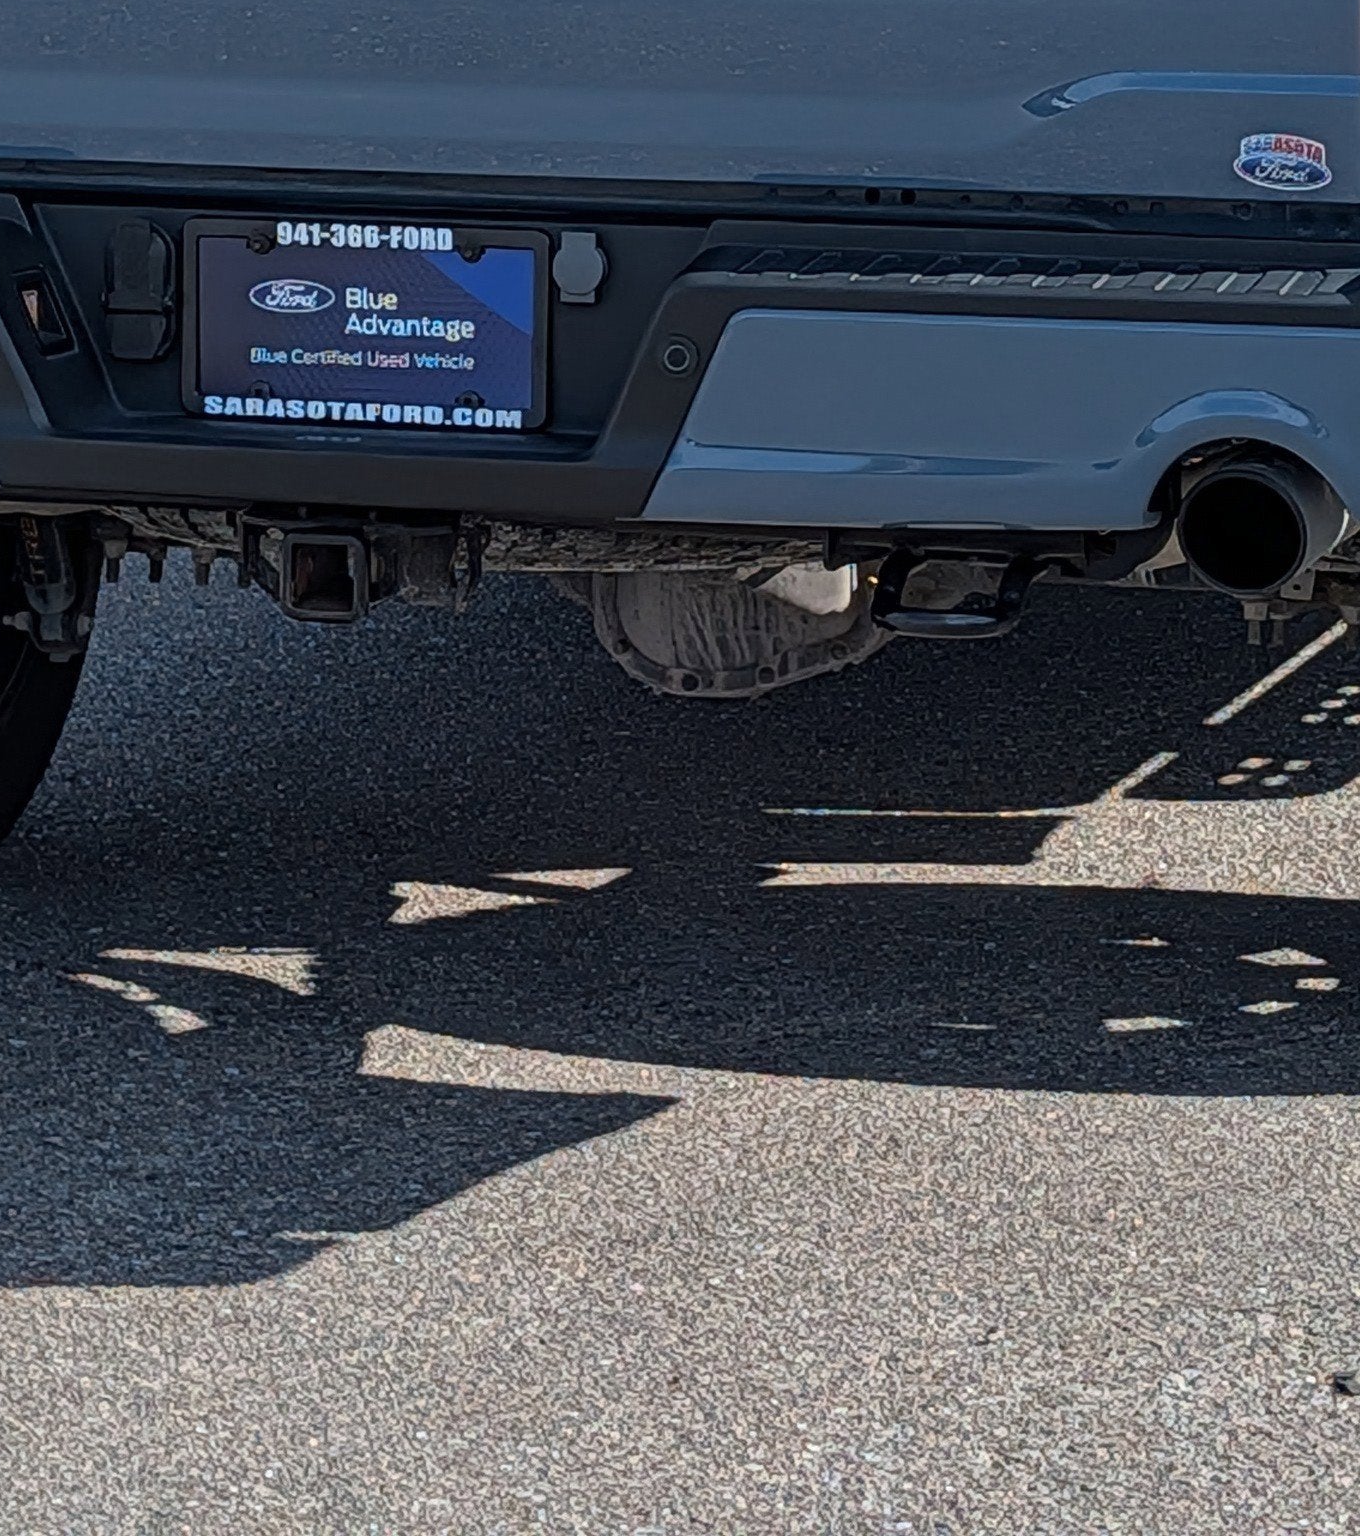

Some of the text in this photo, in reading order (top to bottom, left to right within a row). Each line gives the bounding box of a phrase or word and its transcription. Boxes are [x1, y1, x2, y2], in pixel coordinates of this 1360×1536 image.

[1254, 158, 1310, 183] Ford
[276, 221, 454, 251] 941-366-FORD
[265, 282, 319, 308] Ford
[345, 287, 398, 310] Blue
[344, 313, 475, 342] Advantage
[250, 347, 475, 370] Blue Certified Used Vehicle
[203, 395, 523, 429] SARASOTAFORD.COM
